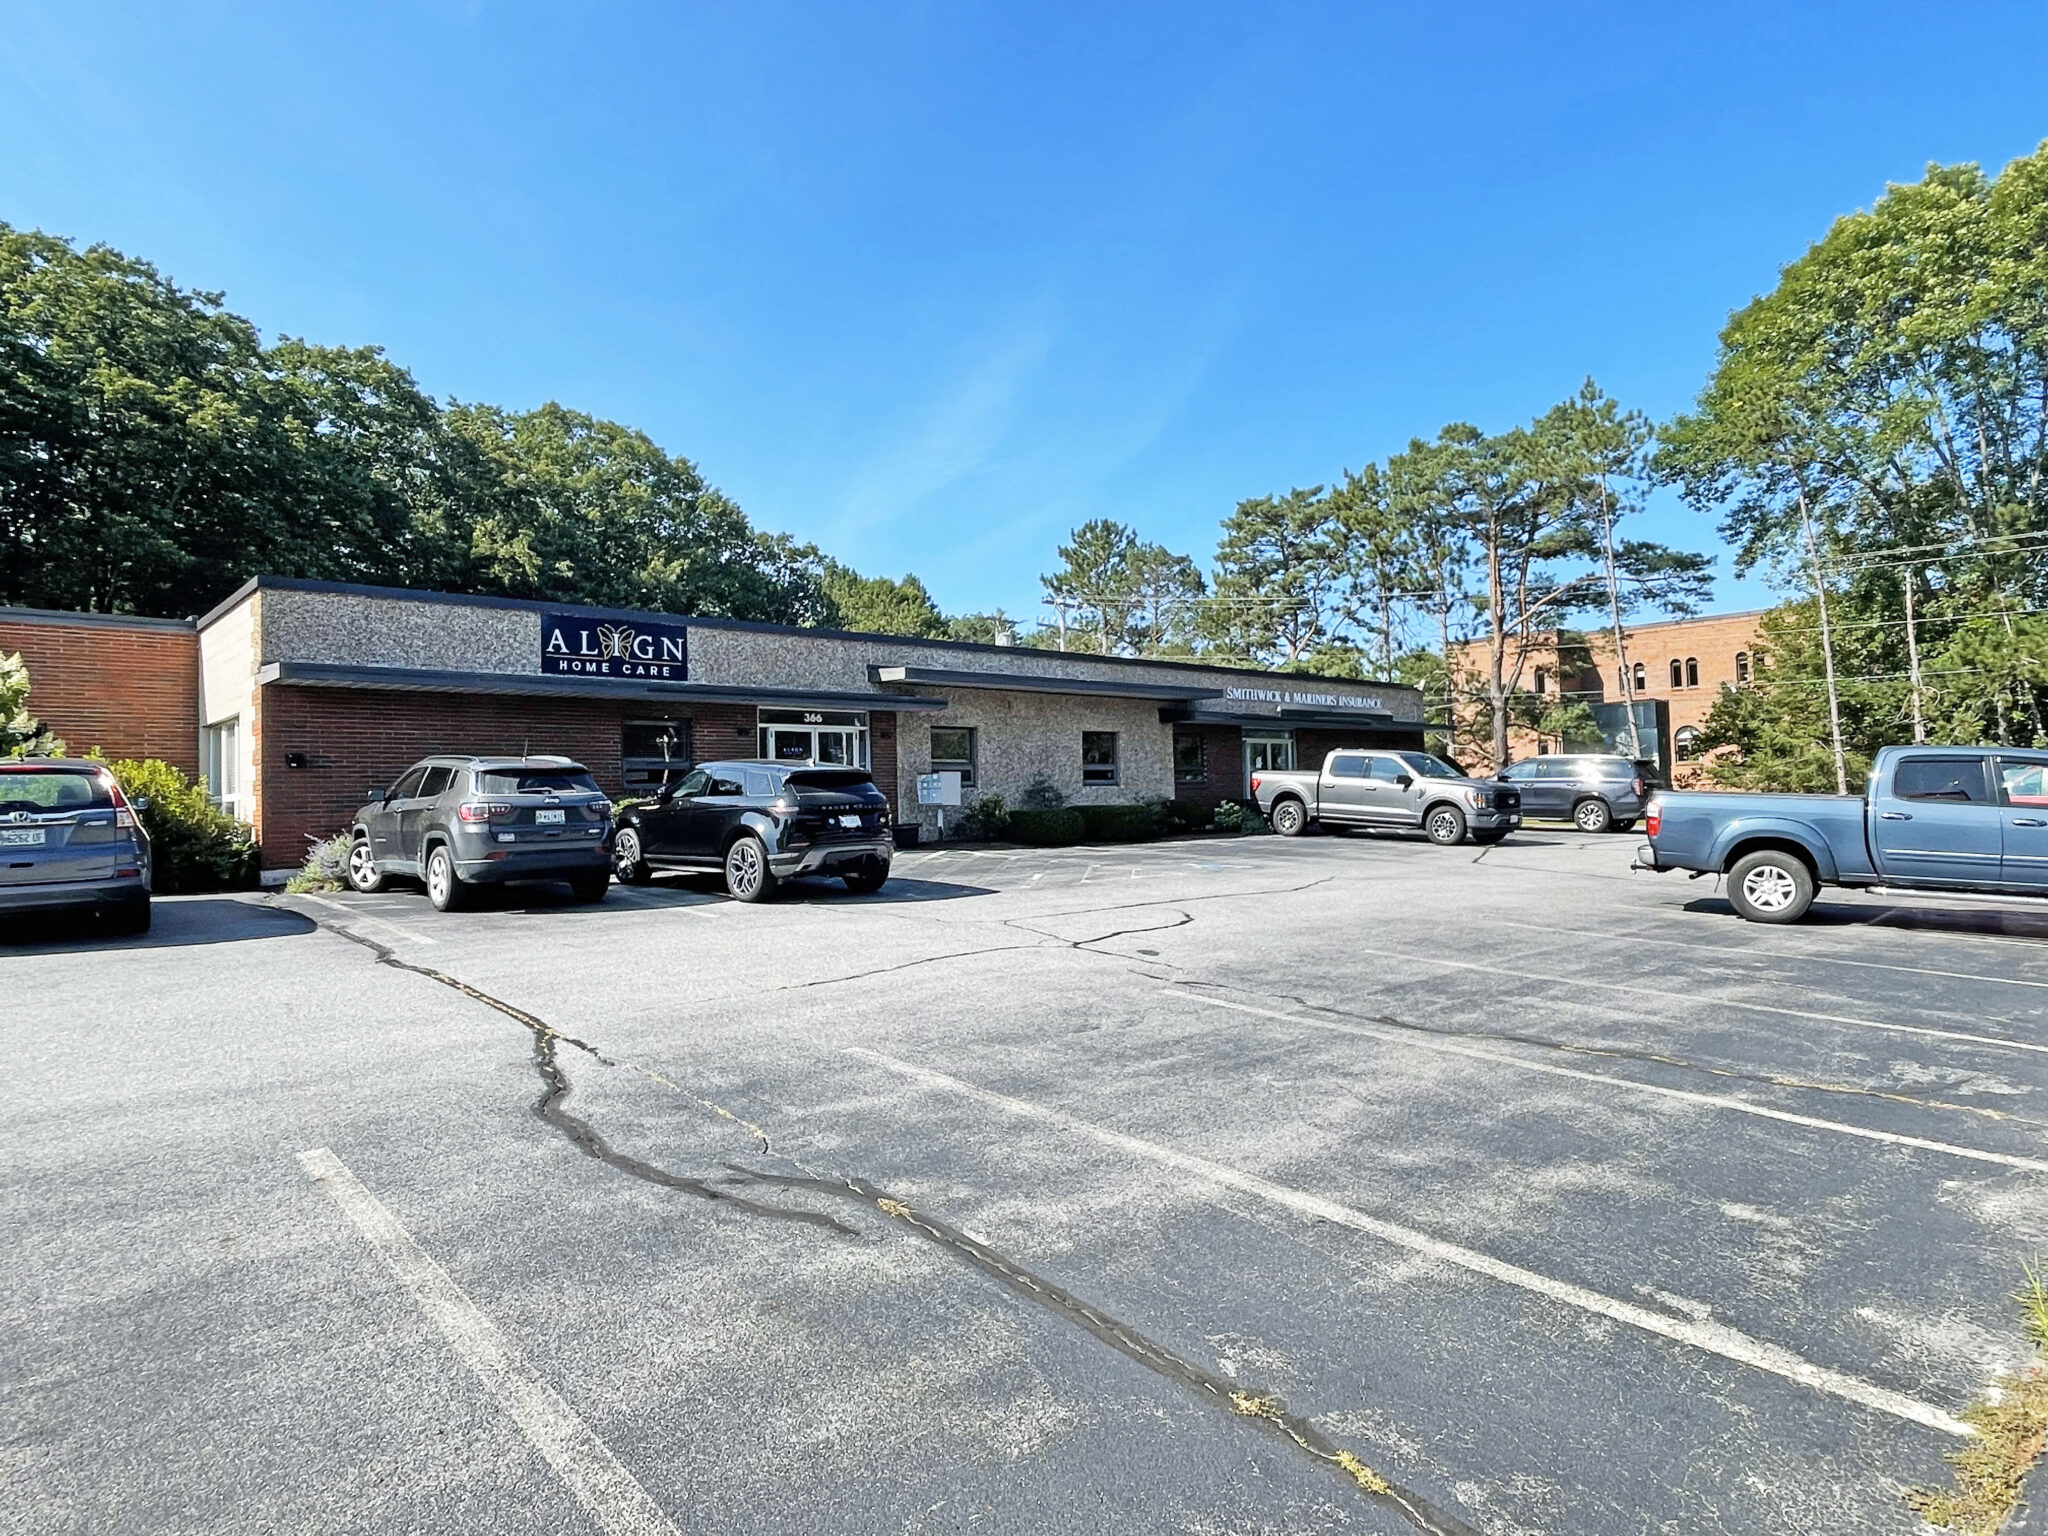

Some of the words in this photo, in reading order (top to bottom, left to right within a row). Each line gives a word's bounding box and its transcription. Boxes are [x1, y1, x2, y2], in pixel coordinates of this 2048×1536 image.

[546, 628, 684, 661] ALIGN
[559, 660, 610, 673] HOME
[622, 664, 670, 677] CARE
[1226, 685, 1282, 703] SMITHWICK
[1284, 691, 1291, 703] &
[1293, 692, 1337, 706] MARINERS
[1338, 695, 1383, 709] INSURANCE
[803, 713, 823, 723] 366
